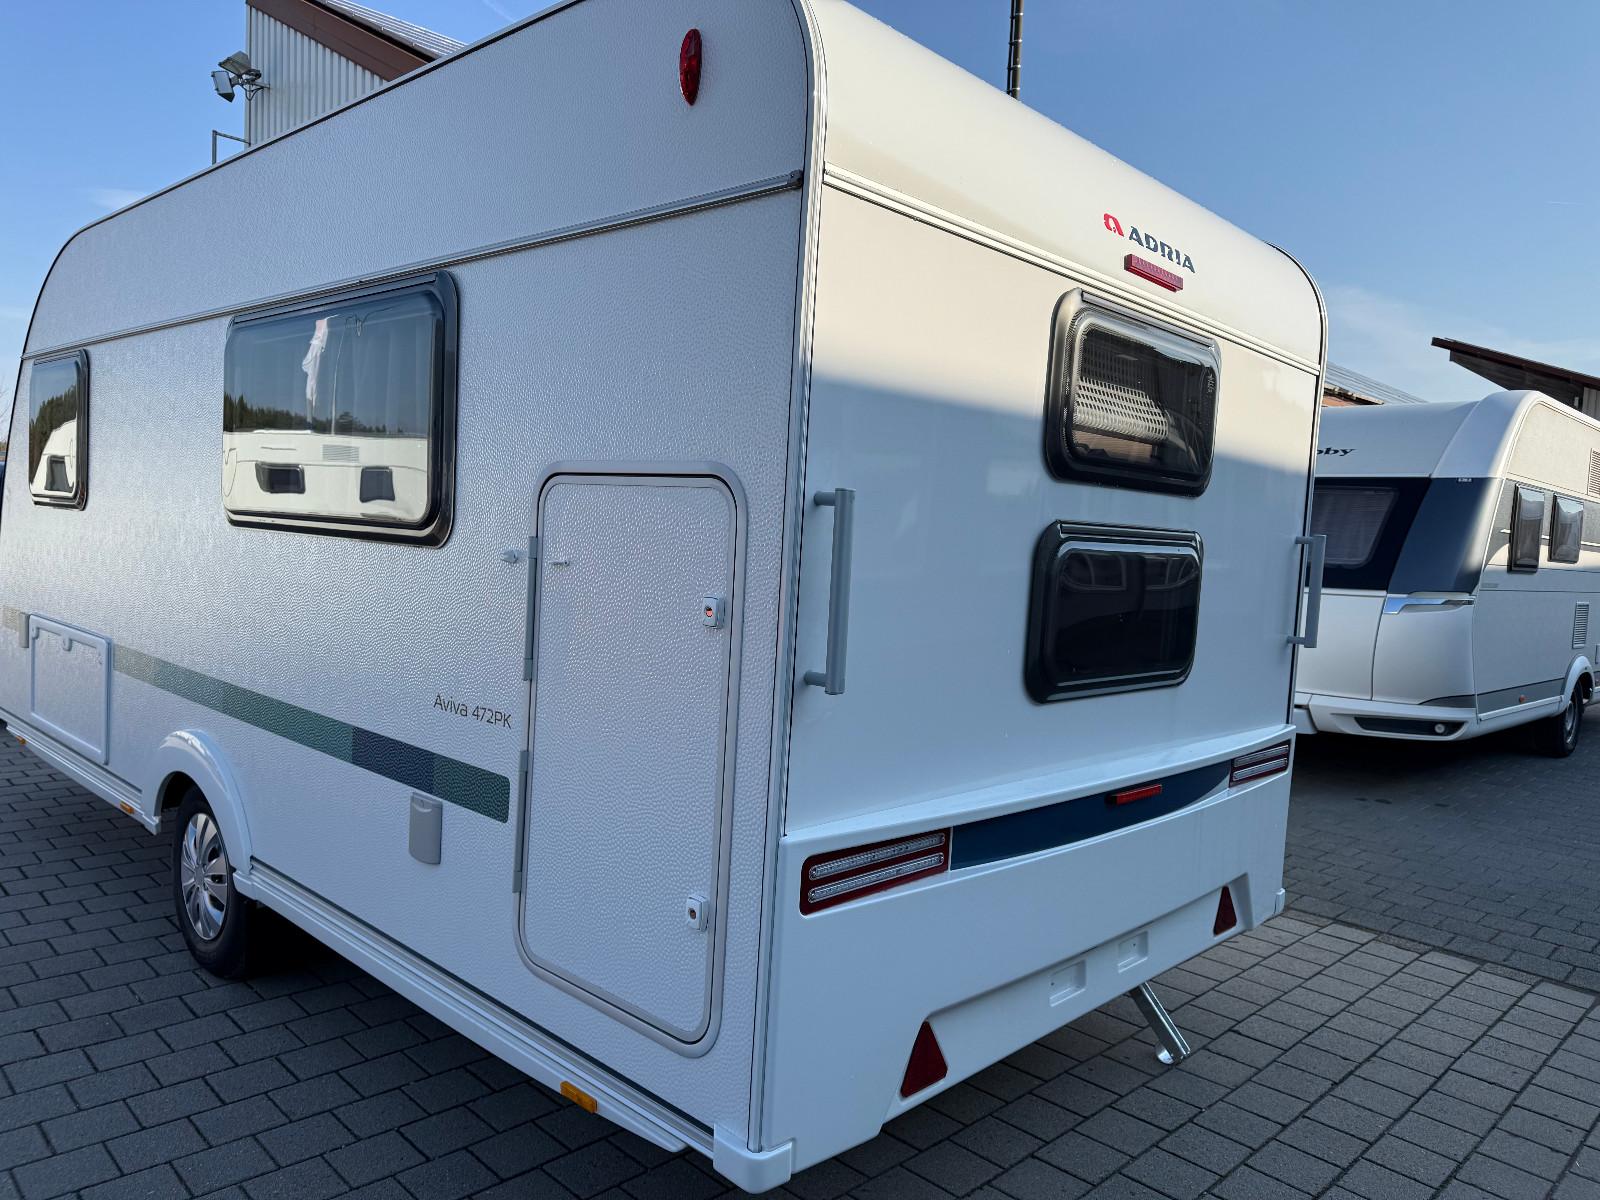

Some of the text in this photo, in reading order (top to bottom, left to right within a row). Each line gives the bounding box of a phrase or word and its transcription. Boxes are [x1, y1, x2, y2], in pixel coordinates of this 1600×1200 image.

[1128, 225, 1196, 274] ADRIA
[433, 692, 512, 730] Aviva 472PK
